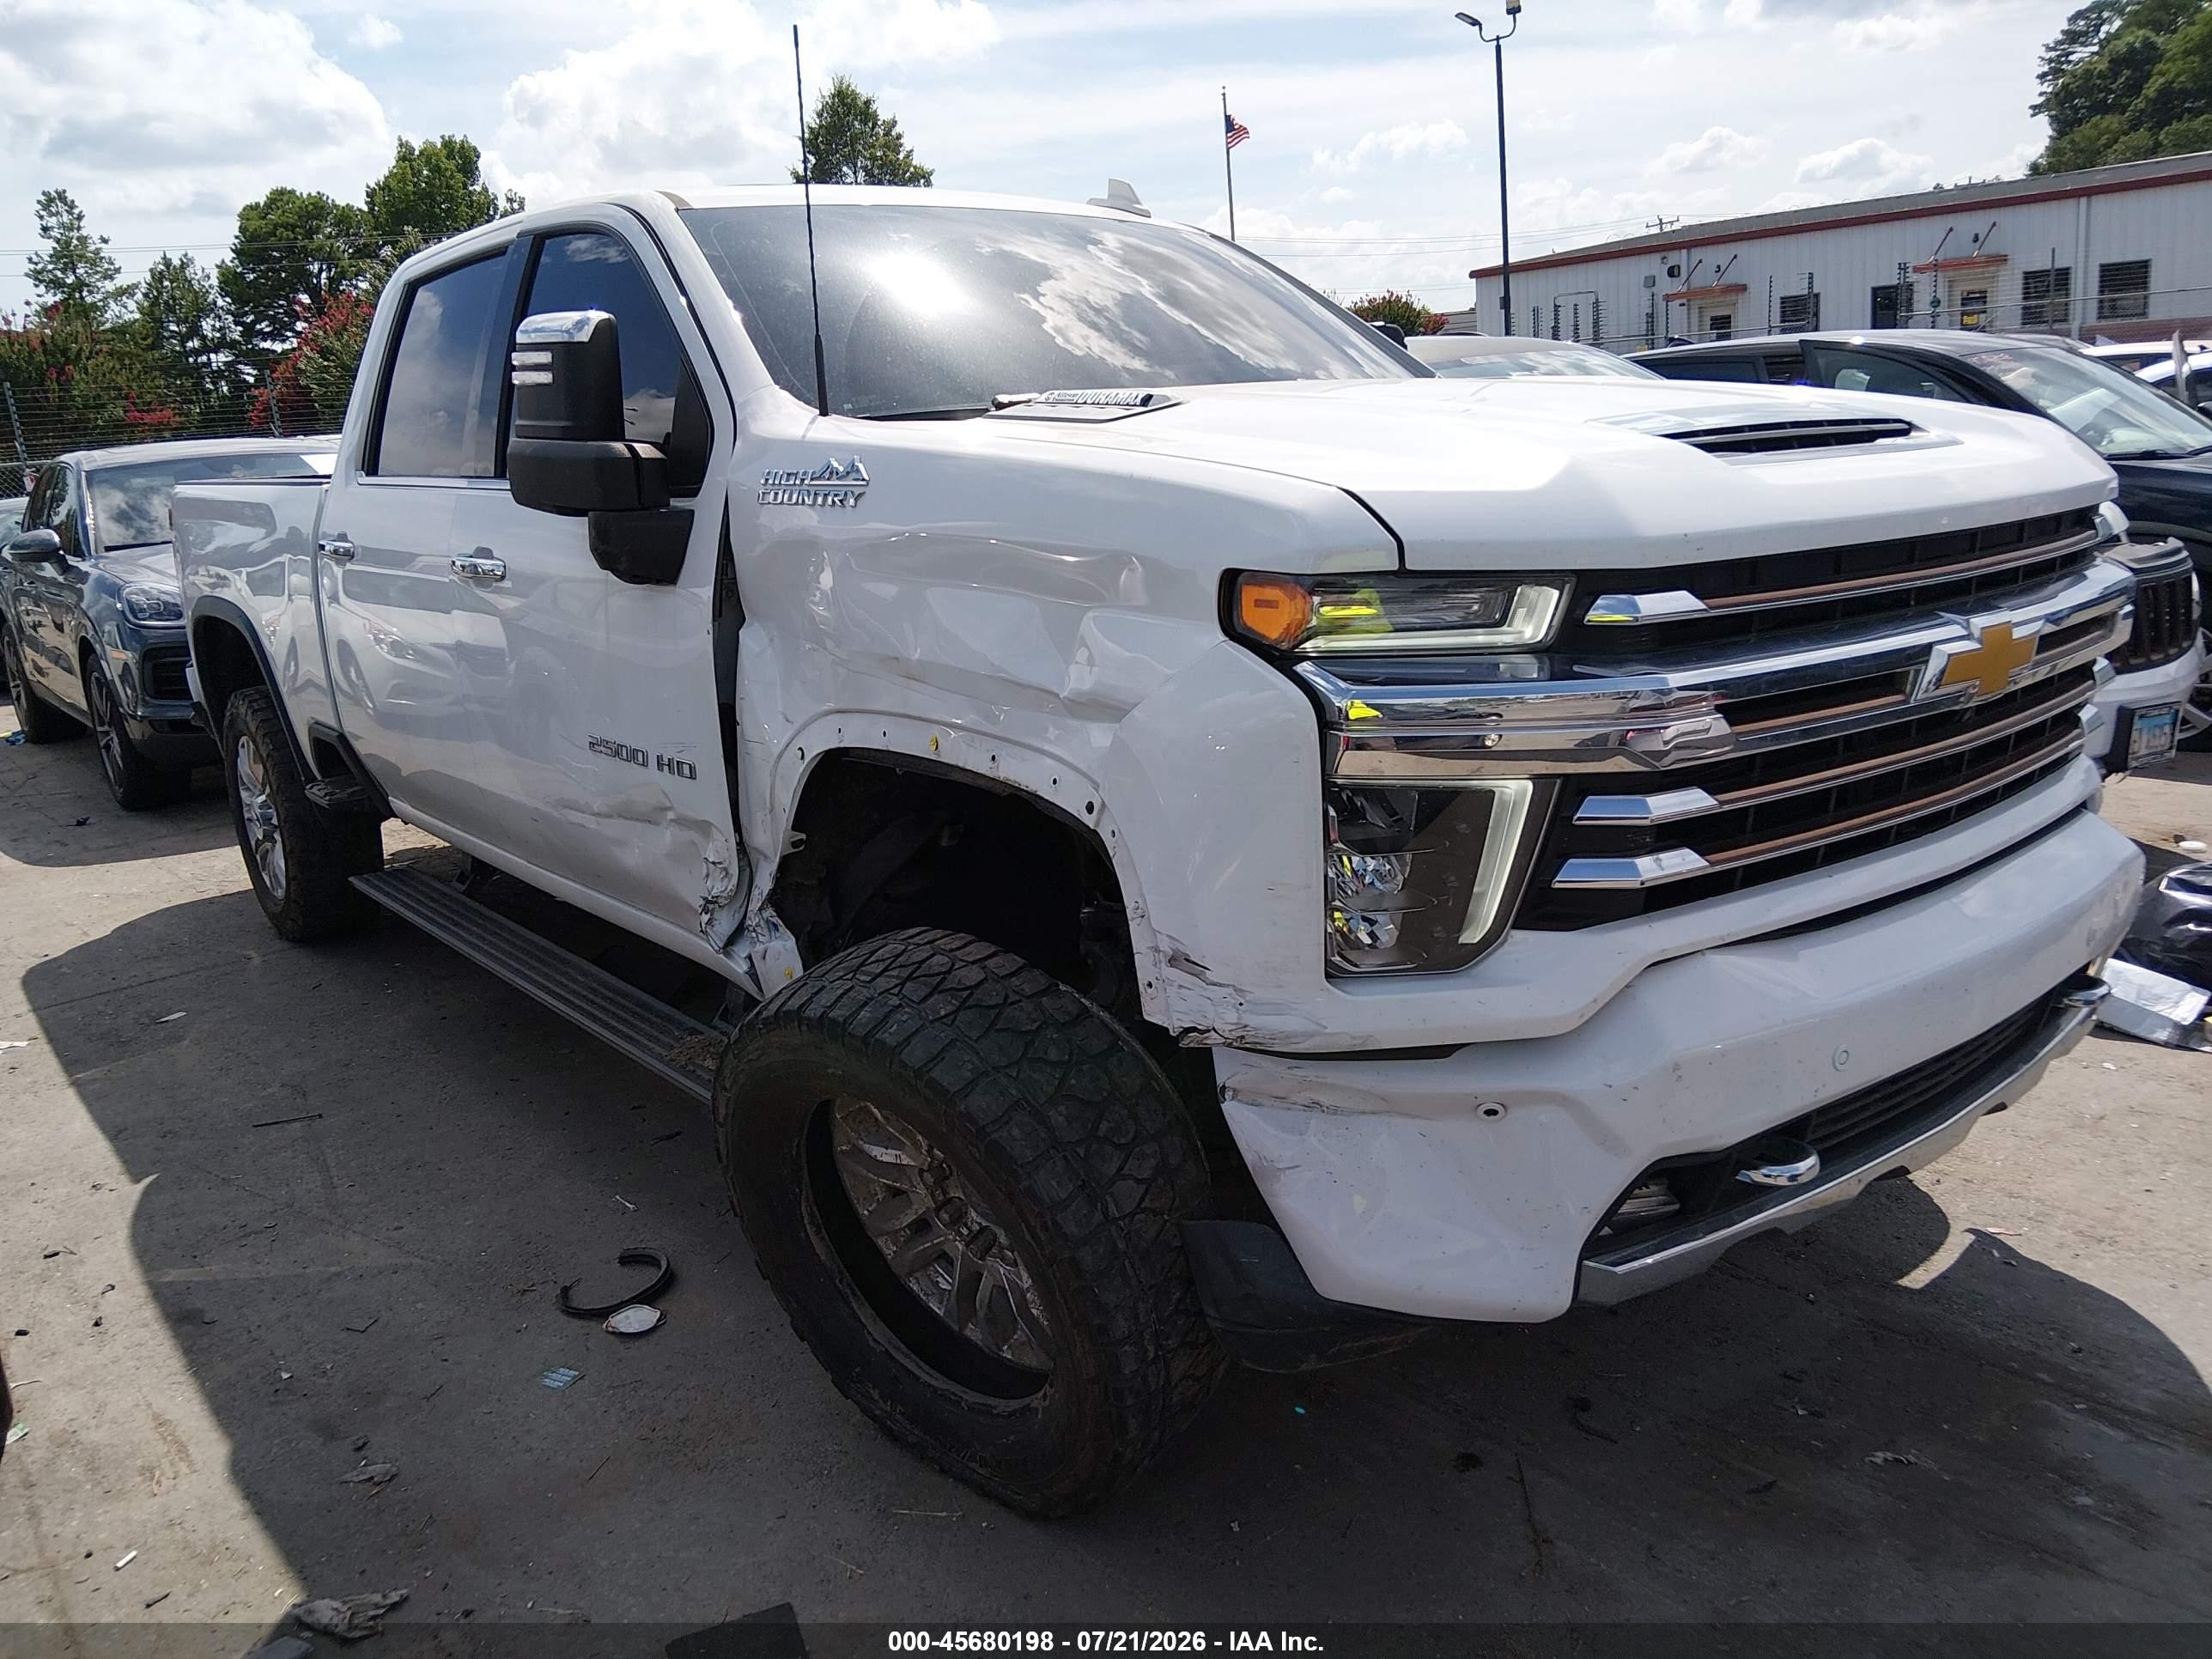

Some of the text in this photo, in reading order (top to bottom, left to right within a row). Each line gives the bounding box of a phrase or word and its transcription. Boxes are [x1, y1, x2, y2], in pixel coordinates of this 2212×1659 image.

[1075, 392, 1142, 406] DURAMAX
[759, 469, 814, 486] HIGH
[757, 488, 866, 507] COUNTRY
[587, 732, 697, 780] 2500 HD
